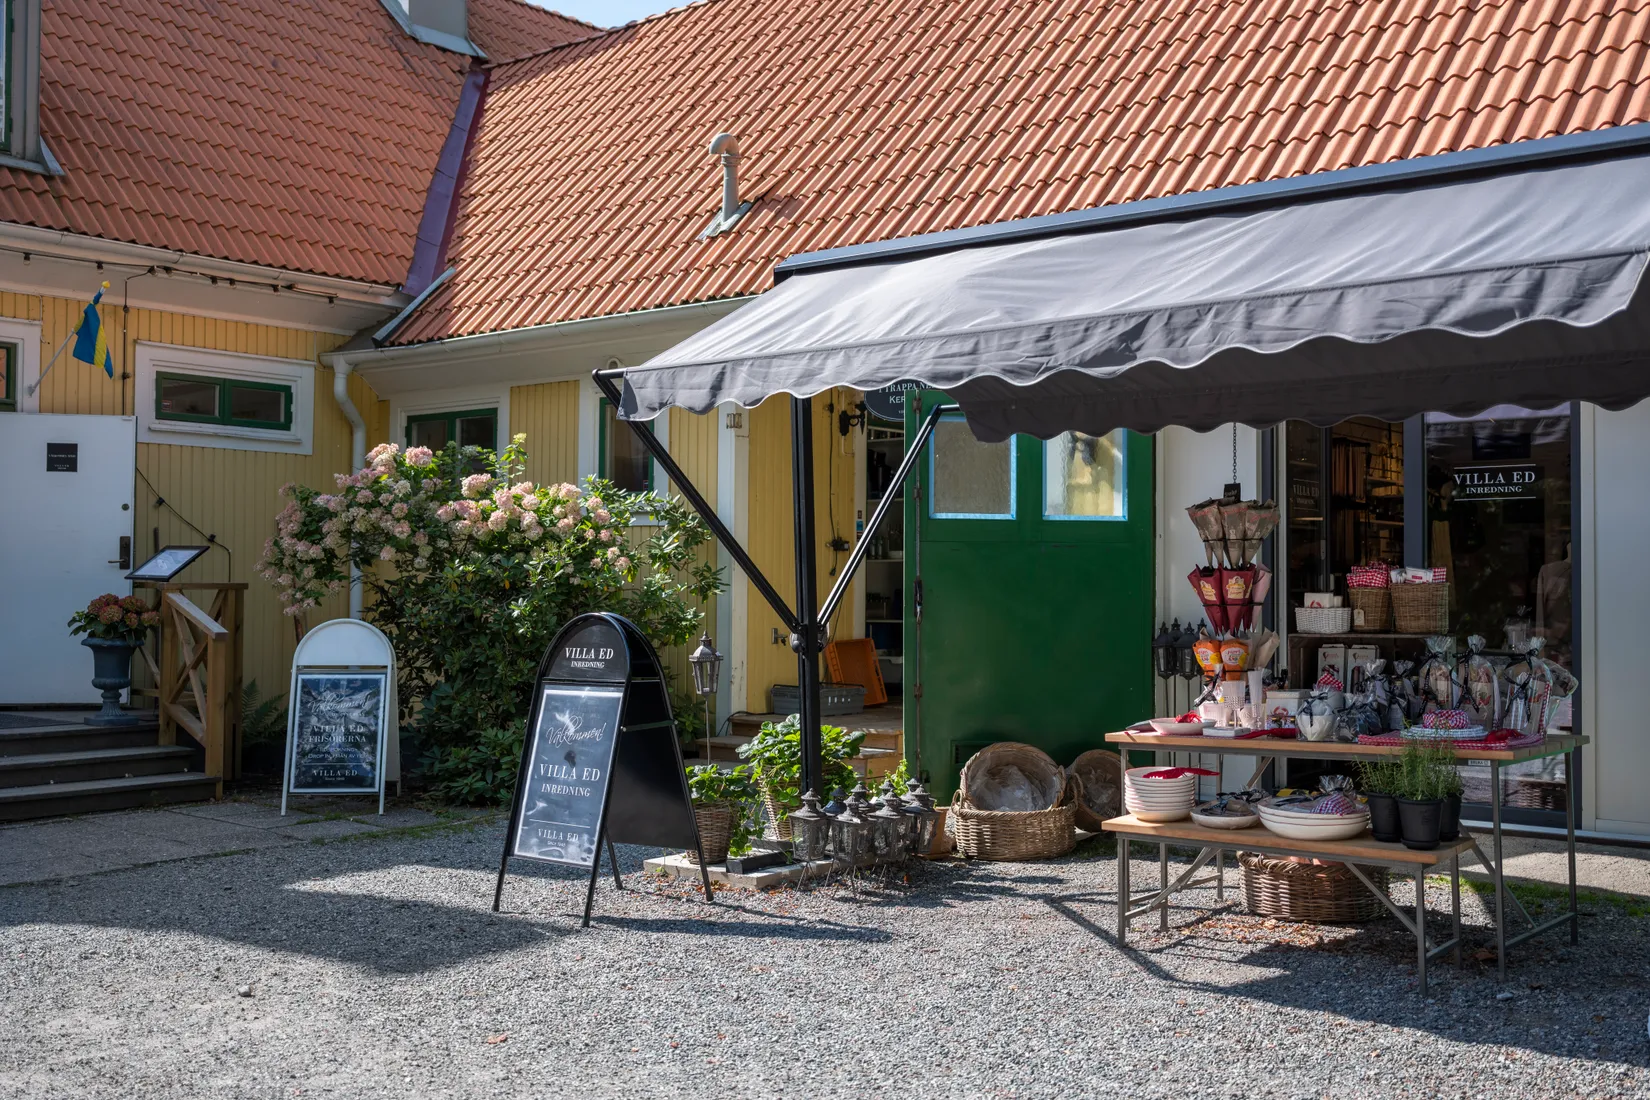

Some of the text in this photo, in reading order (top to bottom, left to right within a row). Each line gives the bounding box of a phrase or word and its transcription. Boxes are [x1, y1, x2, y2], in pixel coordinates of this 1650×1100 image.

[885, 382, 917, 393] TRAPPA
[1453, 471, 1536, 485] VILLA ED
[1466, 485, 1522, 494] INREDNING
[565, 647, 614, 660] VILLA ED
[570, 660, 605, 669] INREDNING
[313, 725, 364, 733] VILLA ED
[540, 763, 600, 781] VILLA ED
[541, 783, 591, 797] INREDNING
[537, 828, 579, 842] VILLA ED
